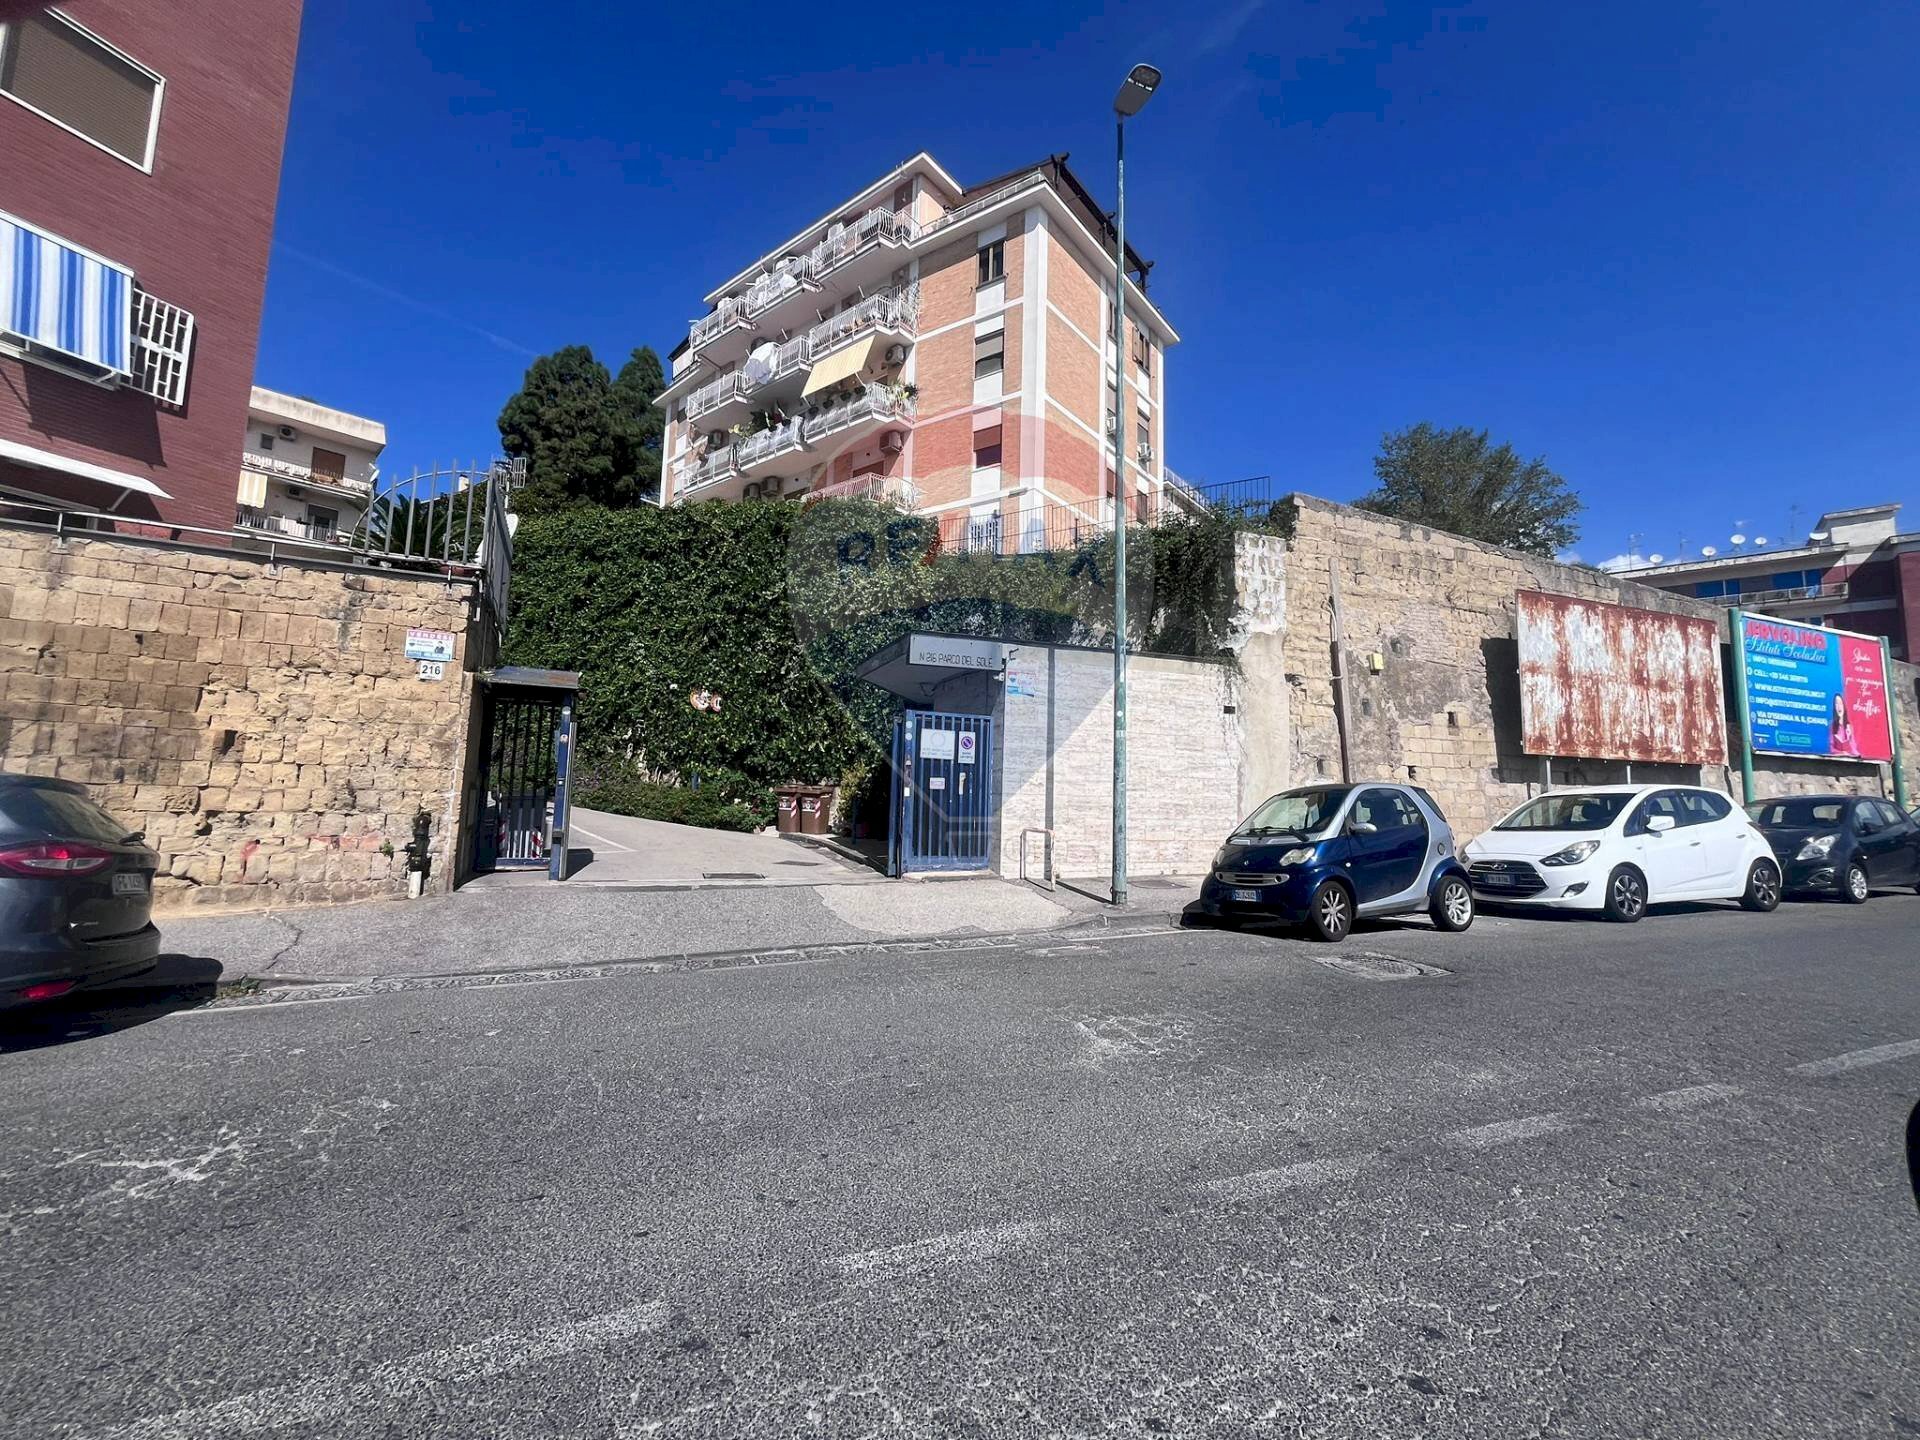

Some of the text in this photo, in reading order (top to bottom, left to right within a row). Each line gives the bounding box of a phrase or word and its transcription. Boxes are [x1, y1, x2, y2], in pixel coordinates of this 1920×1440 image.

[926, 652, 936, 663] 216
[939, 653, 961, 665] PARCO
[961, 655, 975, 666] DEL
[976, 658, 994, 668] SOLE
[421, 664, 441, 675] 216
[1757, 717, 1778, 727] NAPOLI
